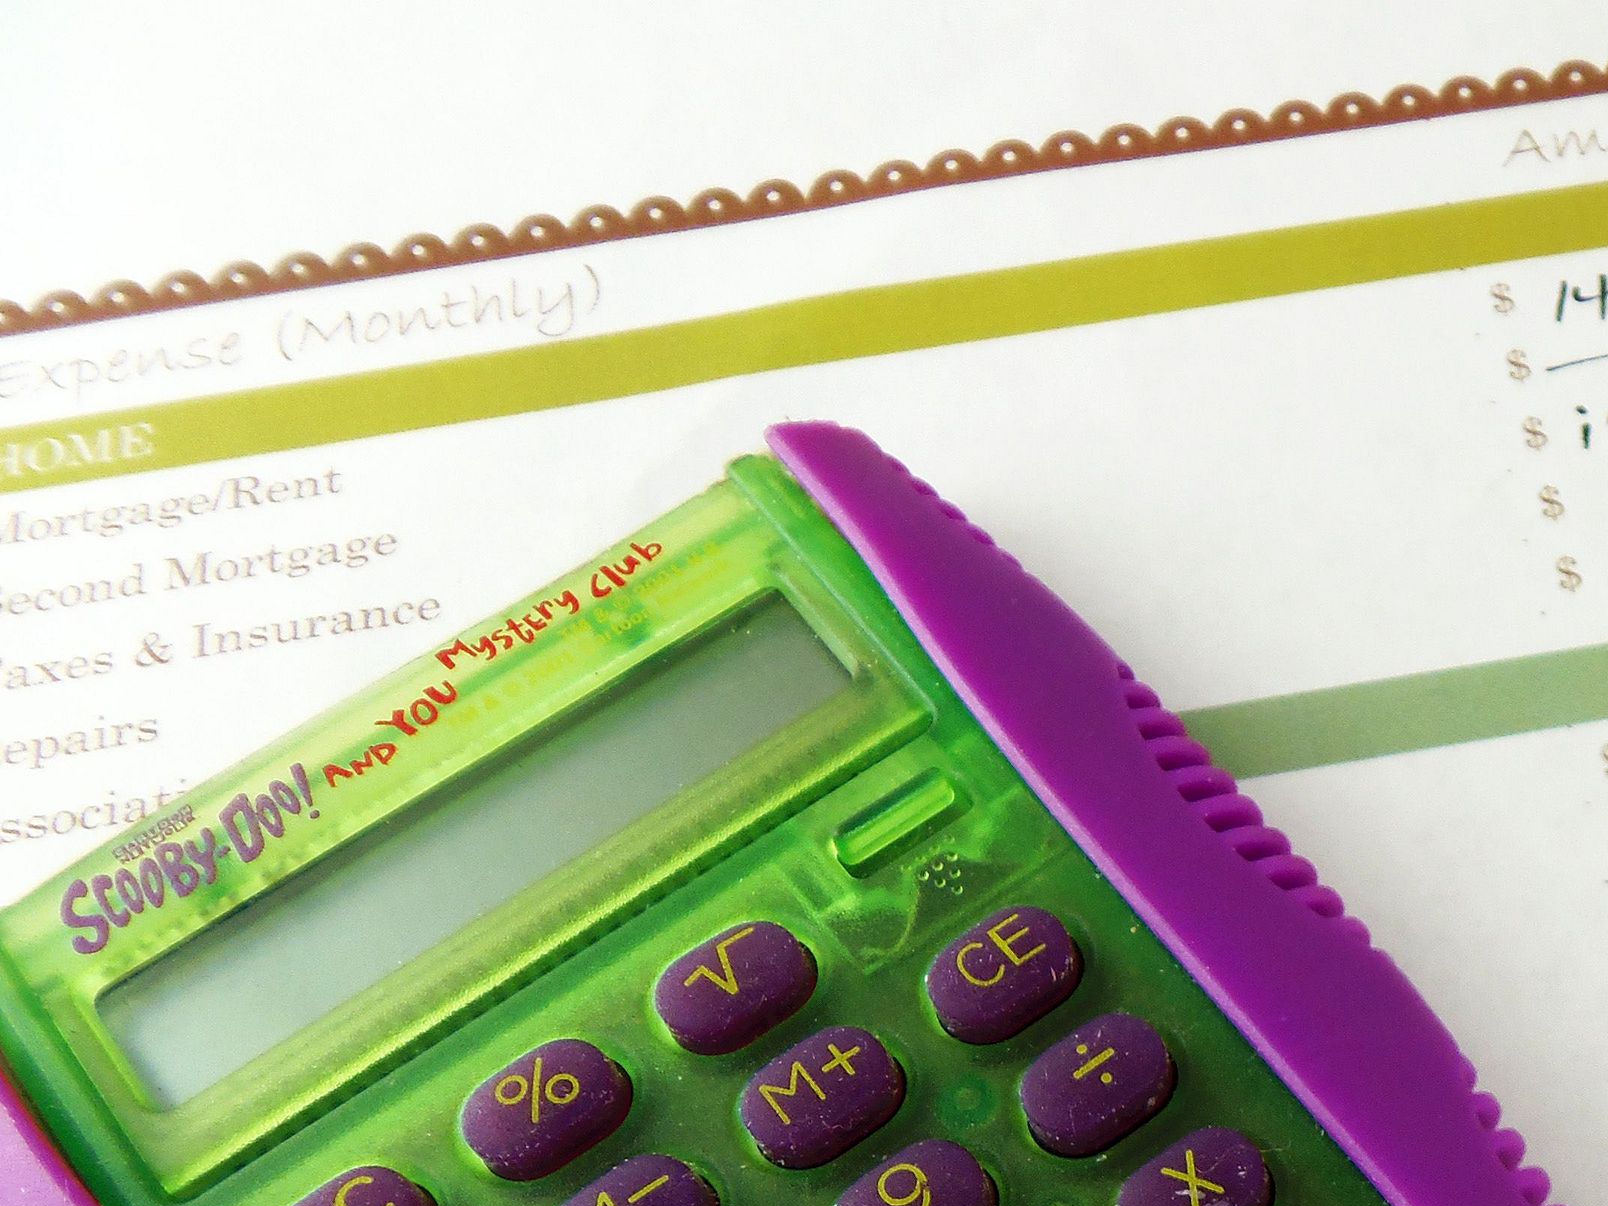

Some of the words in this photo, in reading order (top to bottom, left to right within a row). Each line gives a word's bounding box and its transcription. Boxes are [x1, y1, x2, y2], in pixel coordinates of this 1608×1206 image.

[0, 331, 243, 404] Expense
[276, 265, 602, 362] (Monthly)
[1489, 282, 1516, 316] $
[1506, 350, 1533, 381] $
[1522, 417, 1548, 450] $
[1537, 486, 1566, 520] $
[0, 562, 148, 616] econd
[163, 532, 399, 590] Mortgage
[1556, 555, 1583, 591] $
[0, 651, 114, 690] axes
[135, 631, 173, 668] &
[192, 597, 442, 658] Insurance
[321, 742, 397, 788] AND
[375, 680, 458, 737] YOU
[956, 913, 1047, 988] CE
[757, 1041, 862, 1126] M+
